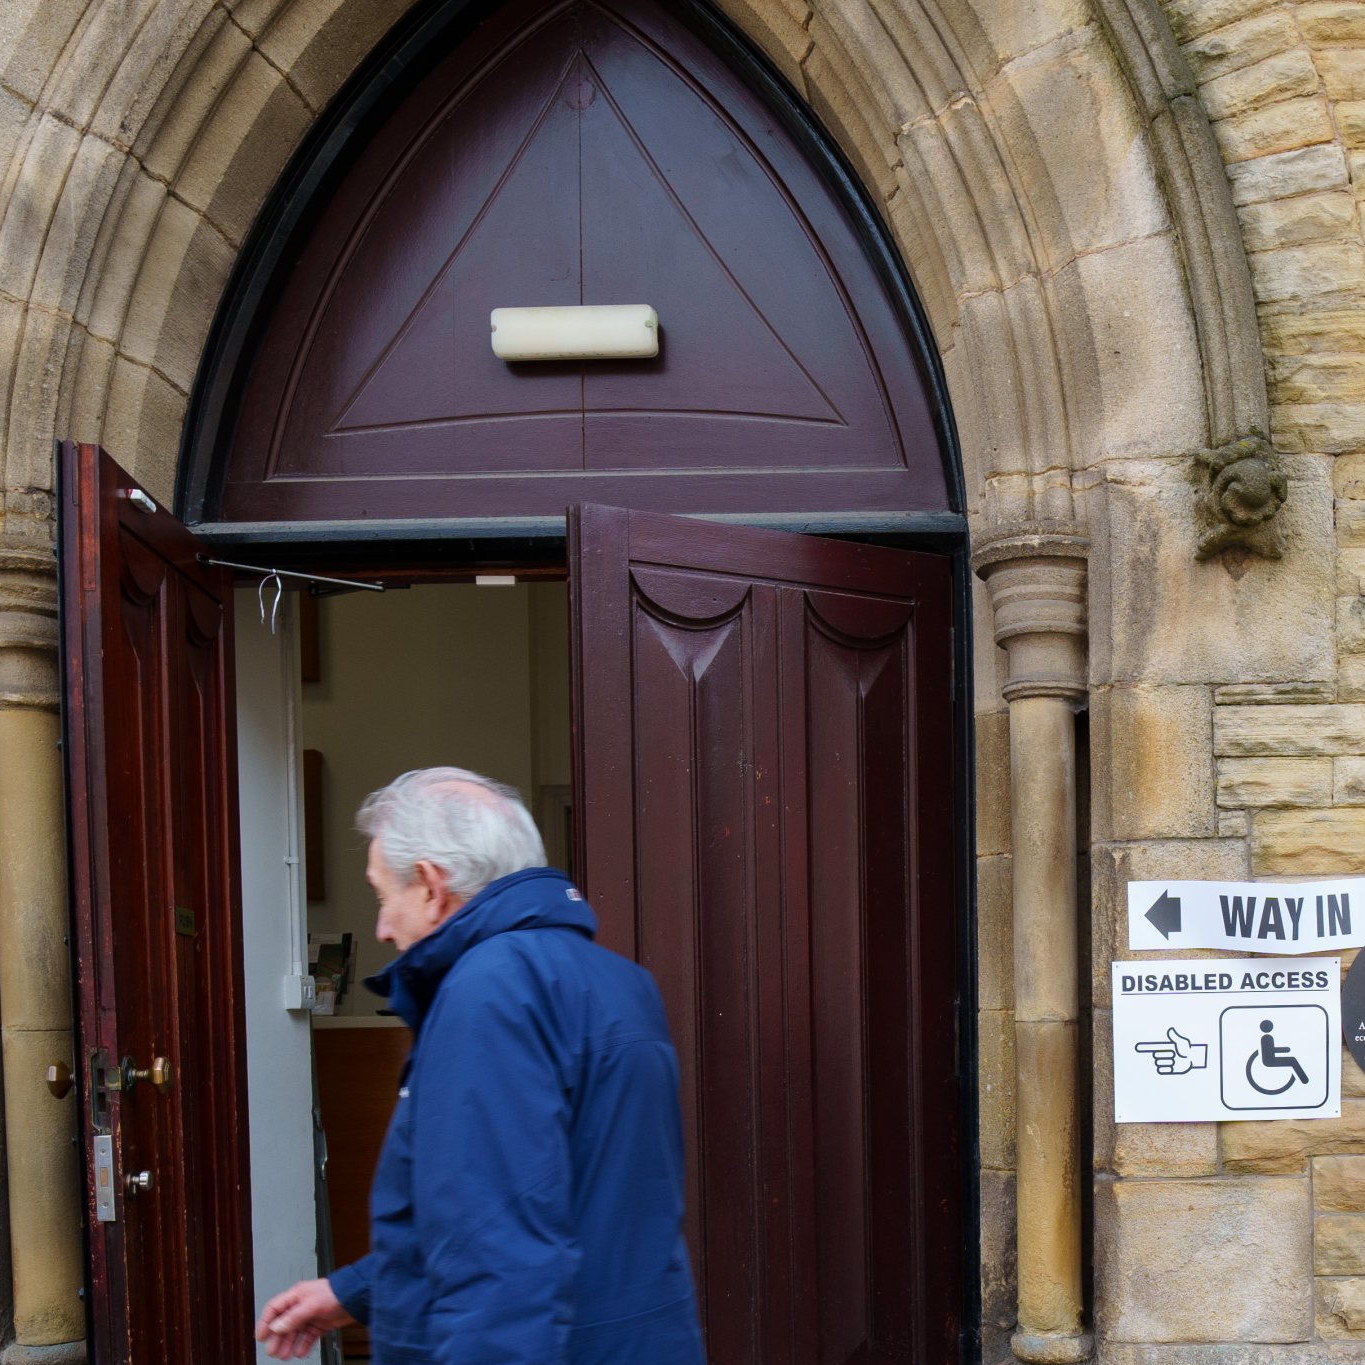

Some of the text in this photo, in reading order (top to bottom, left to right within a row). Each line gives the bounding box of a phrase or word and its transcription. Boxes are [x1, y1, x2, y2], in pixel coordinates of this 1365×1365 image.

[1219, 893, 1352, 941] WAY IN
[1121, 970, 1329, 992] DISABLED ACCESS
[1358, 1021, 1365, 1030] A
